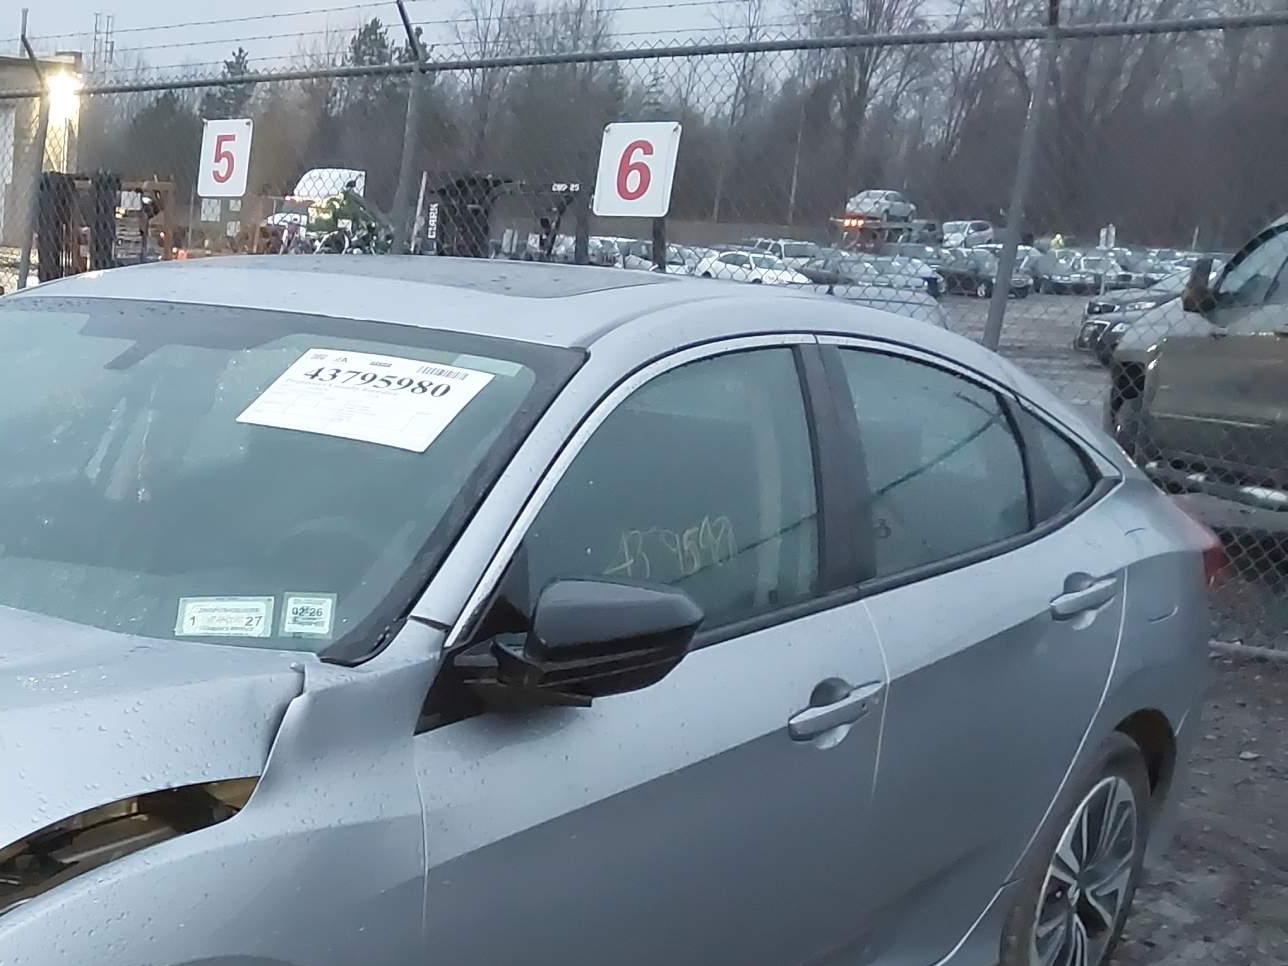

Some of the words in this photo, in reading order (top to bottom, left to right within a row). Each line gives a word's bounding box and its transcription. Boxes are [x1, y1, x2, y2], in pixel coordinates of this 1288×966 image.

[212, 134, 235, 183] 5
[616, 140, 654, 200] 6
[428, 203, 439, 239] CLARK
[304, 366, 451, 397] 43795980
[244, 615, 263, 627] 27
